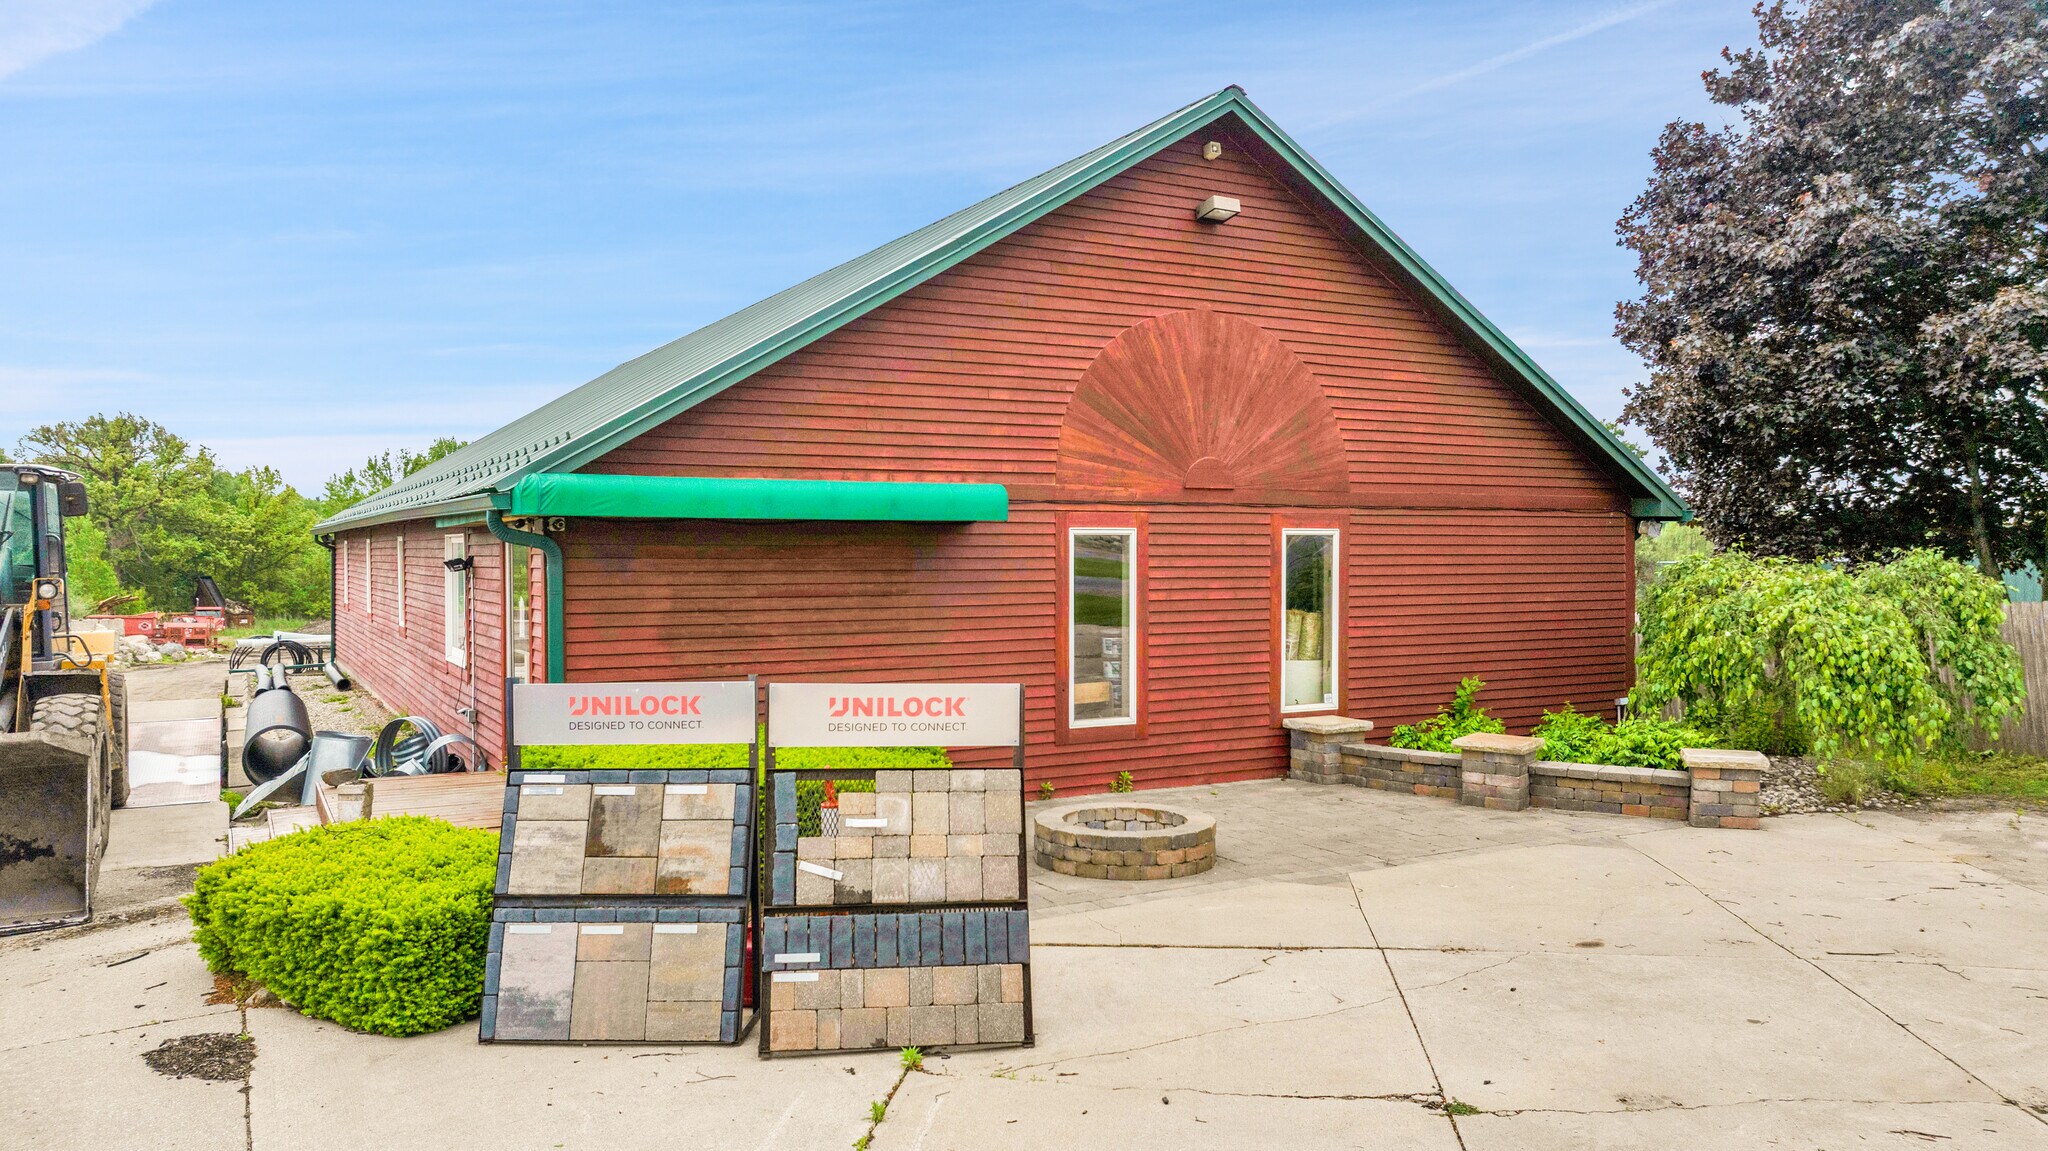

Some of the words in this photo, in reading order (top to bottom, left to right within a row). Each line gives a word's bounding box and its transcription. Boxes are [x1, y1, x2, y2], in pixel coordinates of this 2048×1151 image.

[569, 695, 701, 716] UNILOCK
[829, 697, 966, 717] UNILOCK
[569, 721, 625, 731] DESIGNED
[629, 721, 644, 730] TO
[828, 722, 887, 732] DESIGNED
[892, 722, 907, 731] TO
